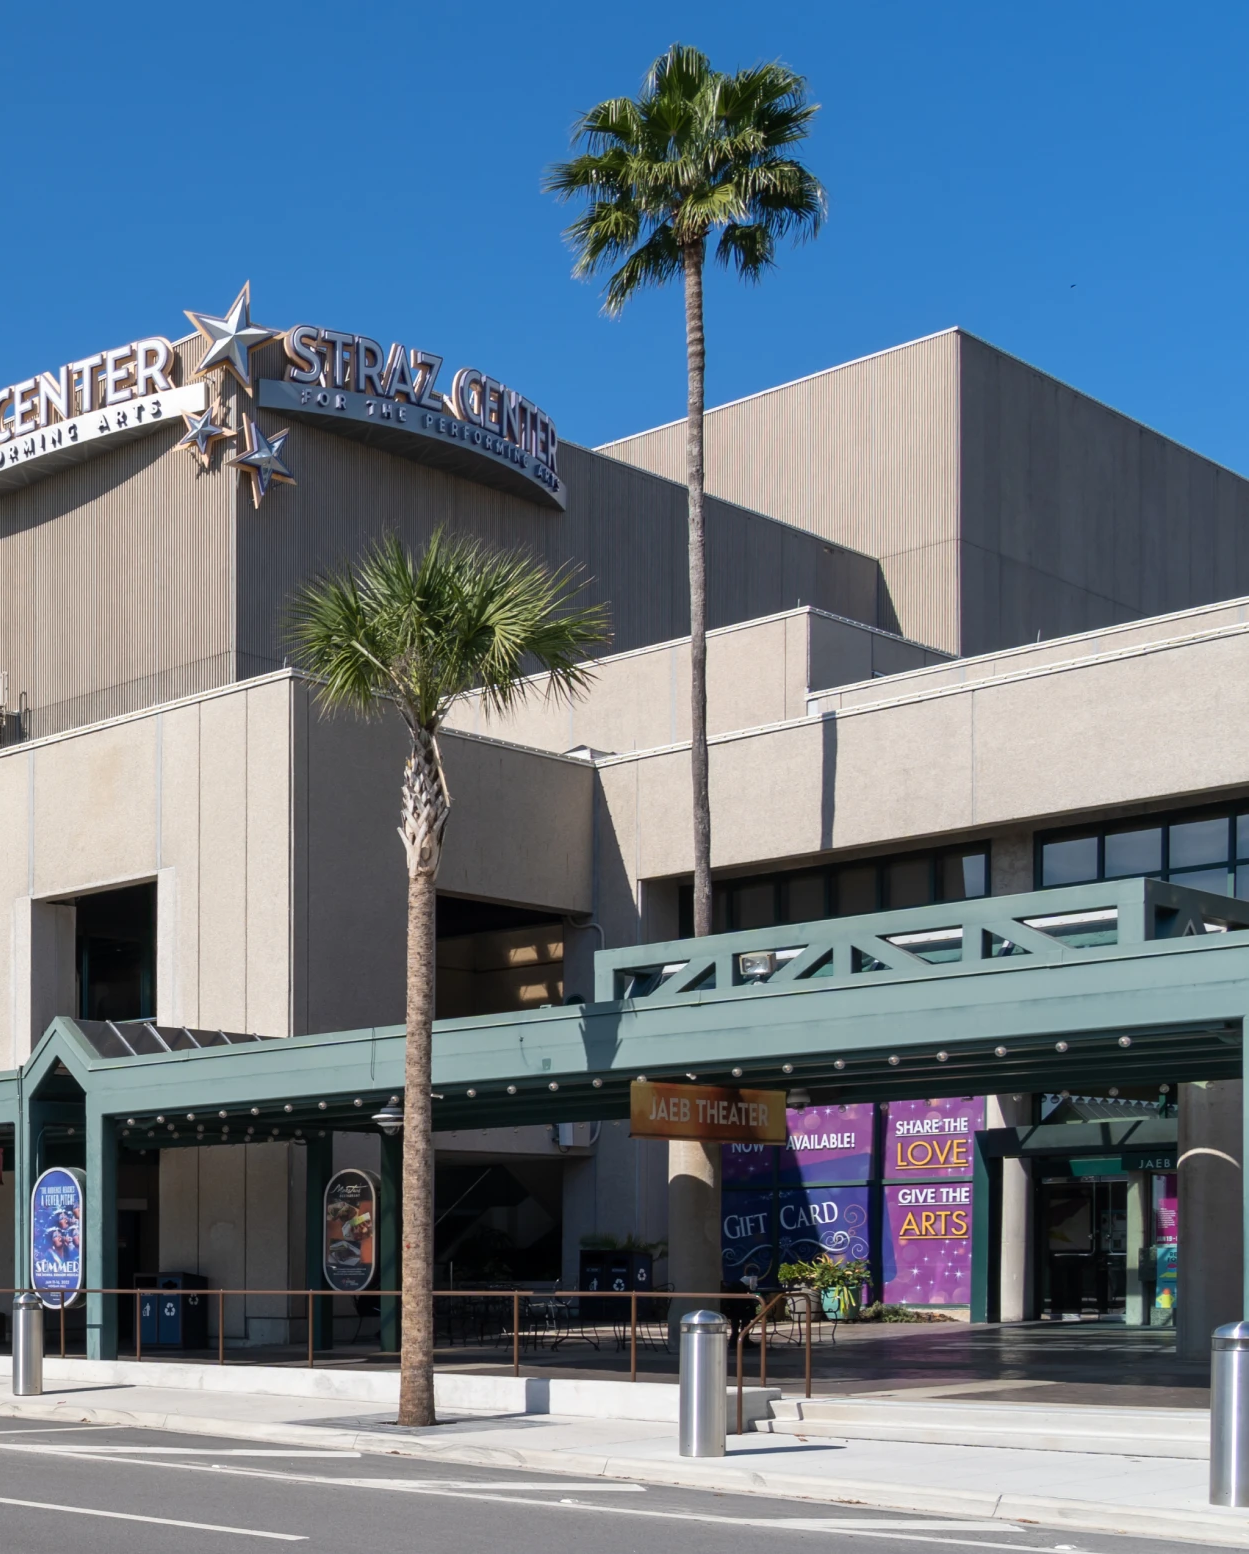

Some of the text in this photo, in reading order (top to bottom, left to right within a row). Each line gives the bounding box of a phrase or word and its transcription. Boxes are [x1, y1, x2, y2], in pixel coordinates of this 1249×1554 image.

[285, 325, 559, 473] STRAZ CENTER
[97, 400, 163, 433] ARTS
[300, 388, 562, 491] FOR THE PERFORMING ARTS
[650, 1097, 770, 1127] JAEB THEATER
[895, 1117, 968, 1135] SHARE THE
[786, 1132, 856, 1151] AVAILABLE!
[897, 1139, 967, 1166] LOVE
[1138, 1158, 1171, 1169] JAEB
[898, 1187, 970, 1203] GIVE THE
[723, 1201, 839, 1240] GIFT CARD
[899, 1210, 968, 1236] ARTS
[35, 1261, 79, 1273] SUMMER
